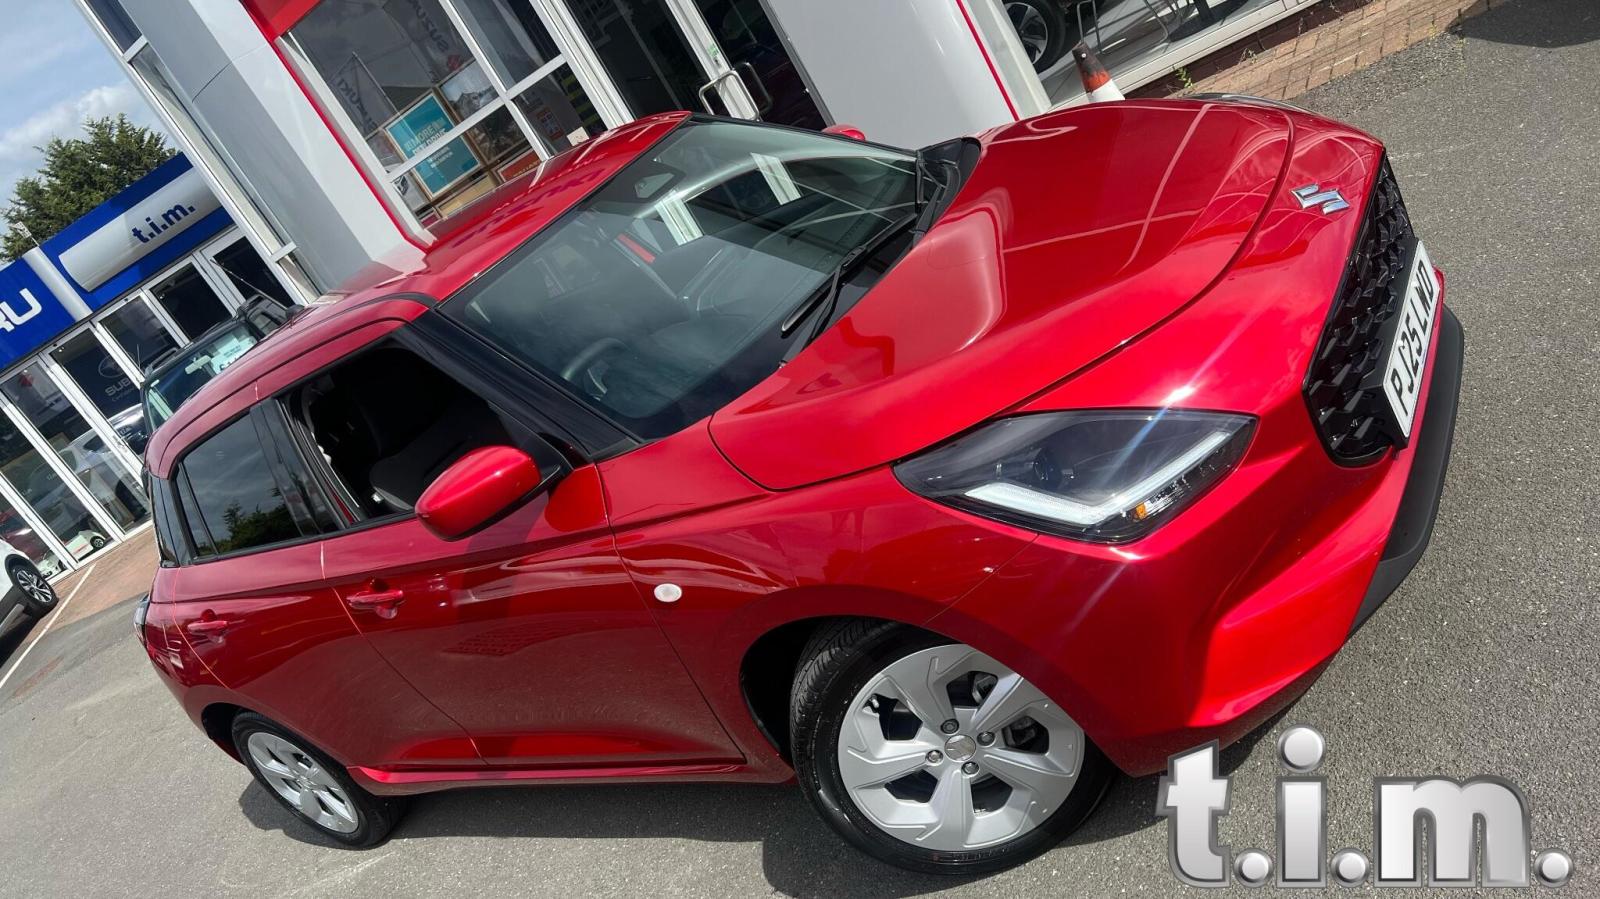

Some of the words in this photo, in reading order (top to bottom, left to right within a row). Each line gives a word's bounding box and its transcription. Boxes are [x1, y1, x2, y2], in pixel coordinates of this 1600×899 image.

[131, 201, 196, 244] t.i.m.
[1391, 313, 1422, 417] PJ25
[1411, 259, 1434, 336] LWD
[104, 377, 136, 397] SUB
